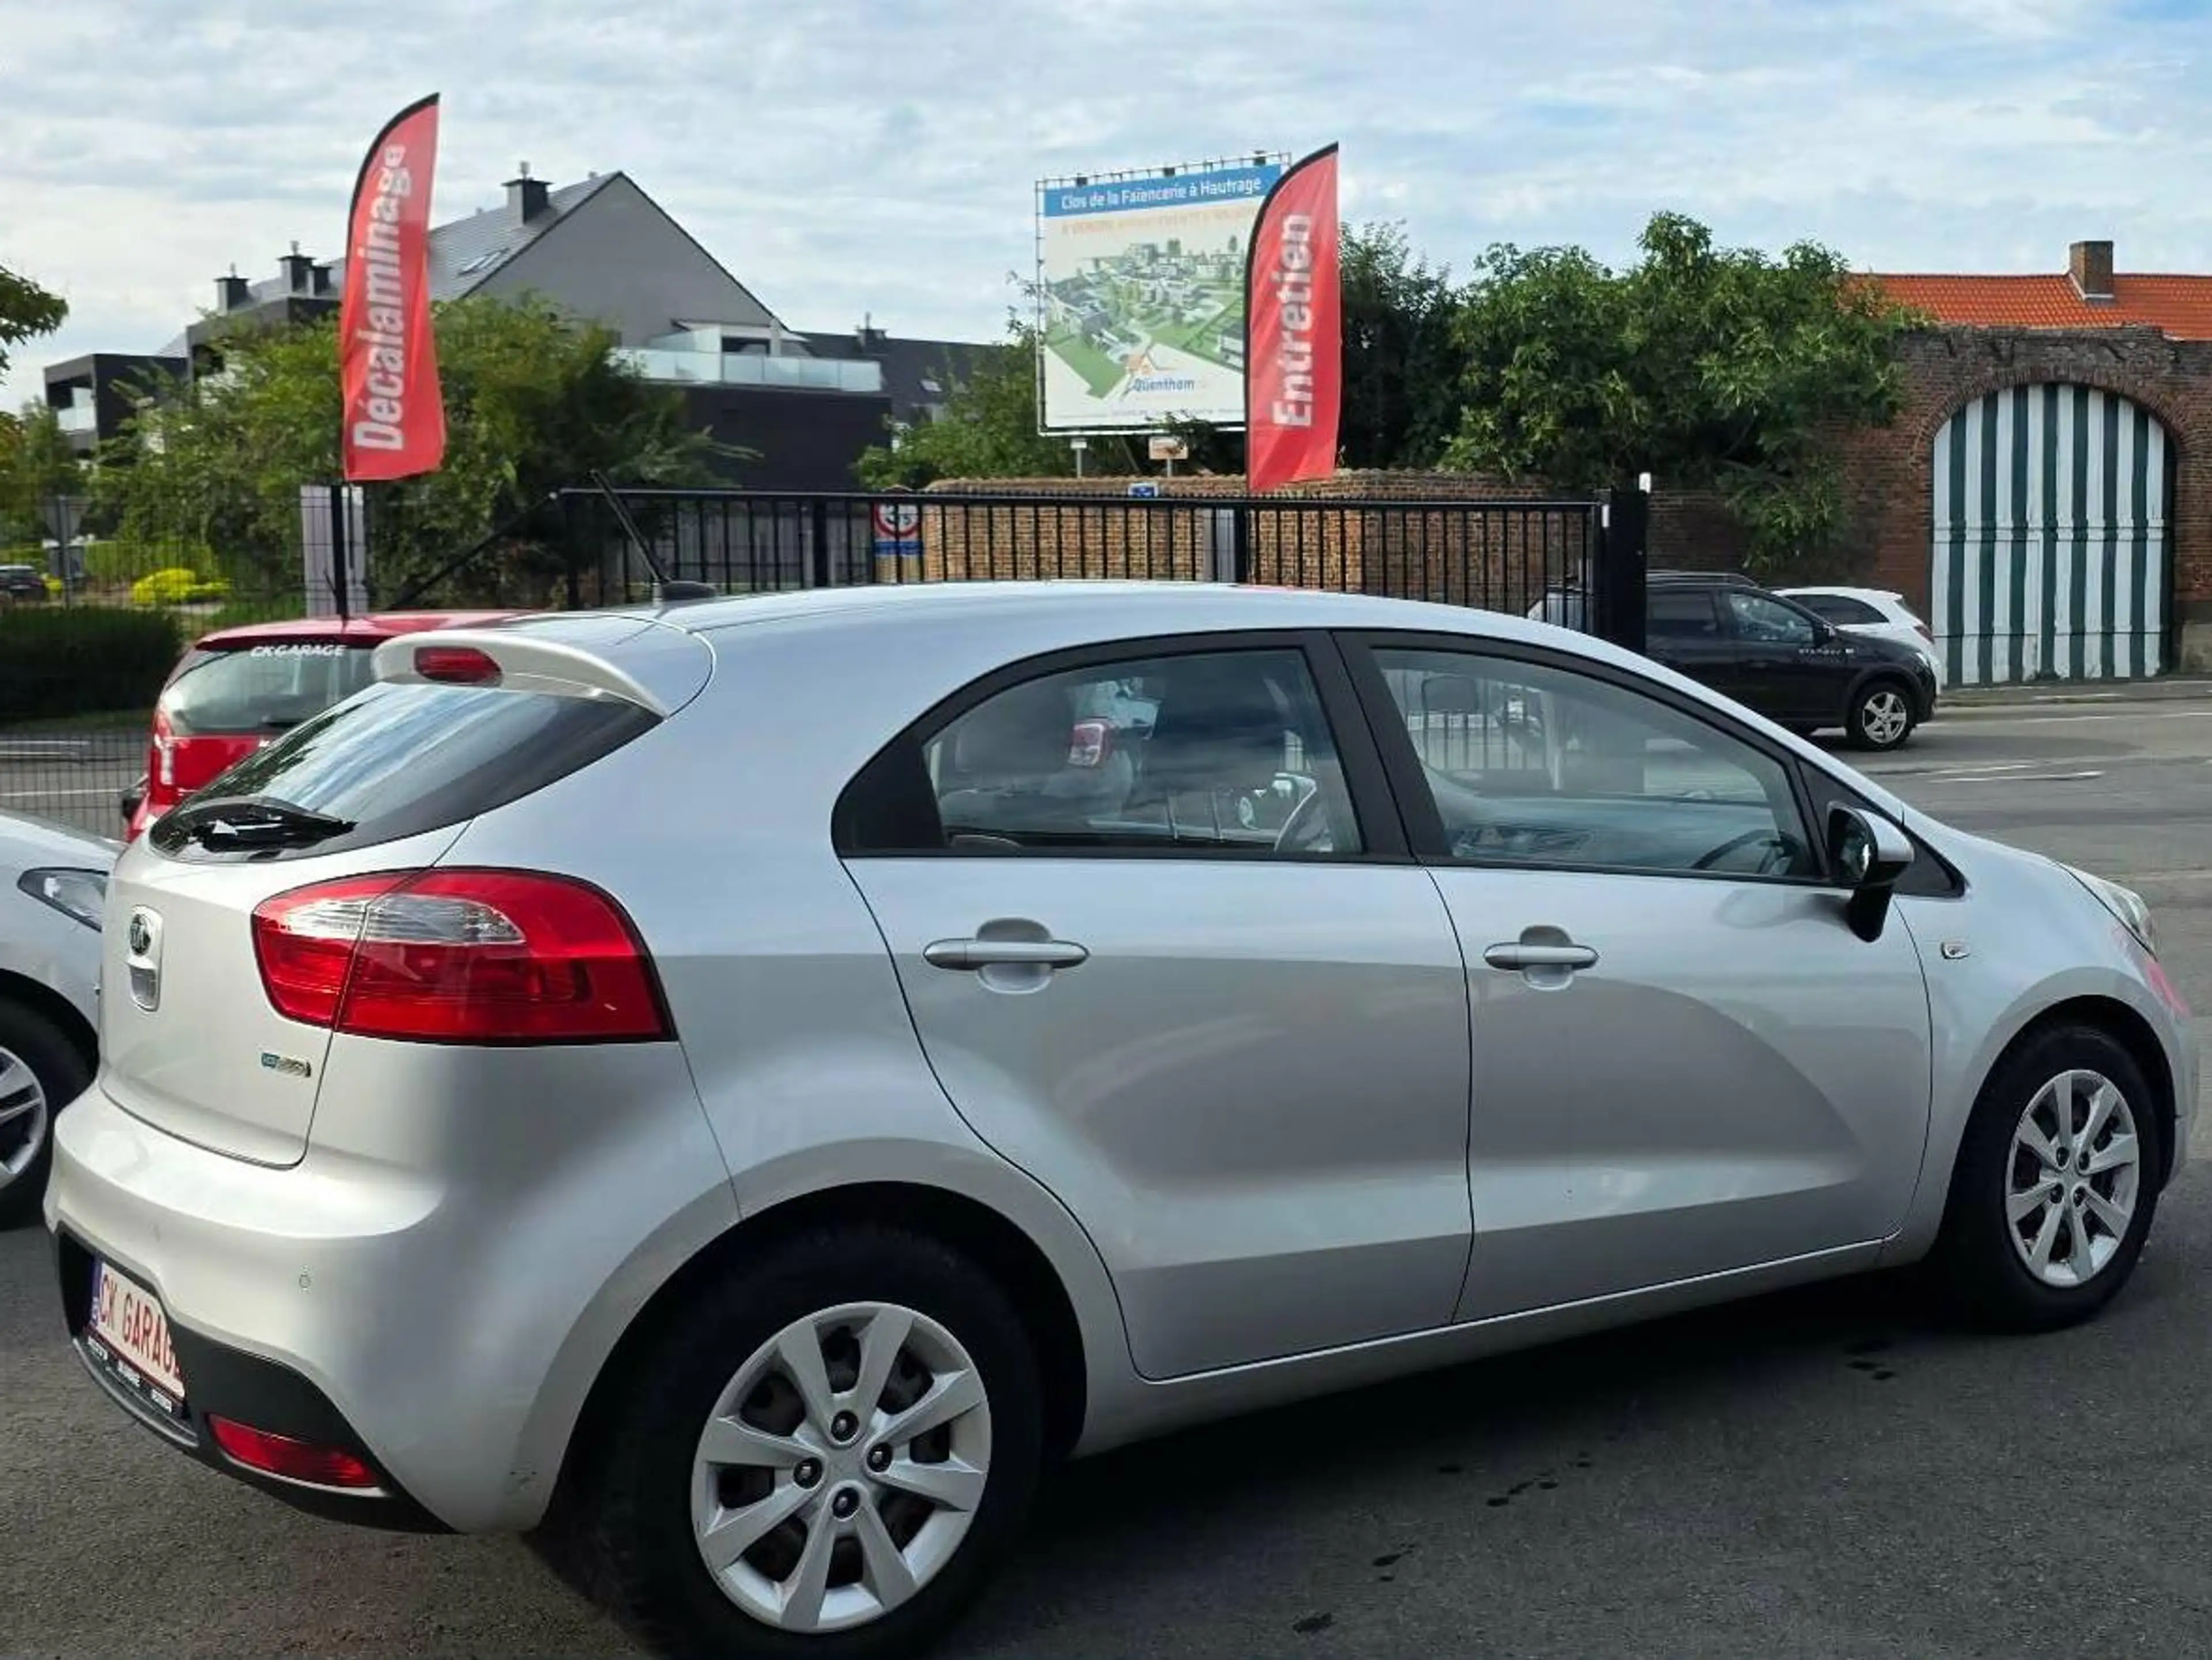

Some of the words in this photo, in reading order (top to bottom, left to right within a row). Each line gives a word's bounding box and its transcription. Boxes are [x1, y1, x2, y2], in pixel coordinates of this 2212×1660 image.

[1062, 195, 1086, 210] Clos
[1089, 194, 1105, 207] de
[1107, 191, 1119, 205] la
[1190, 182, 1199, 197] à
[1201, 177, 1262, 195] Hautrage
[353, 144, 412, 451] Décalaminage
[1271, 214, 1313, 427] Entretien
[100, 1273, 118, 1331] CK
